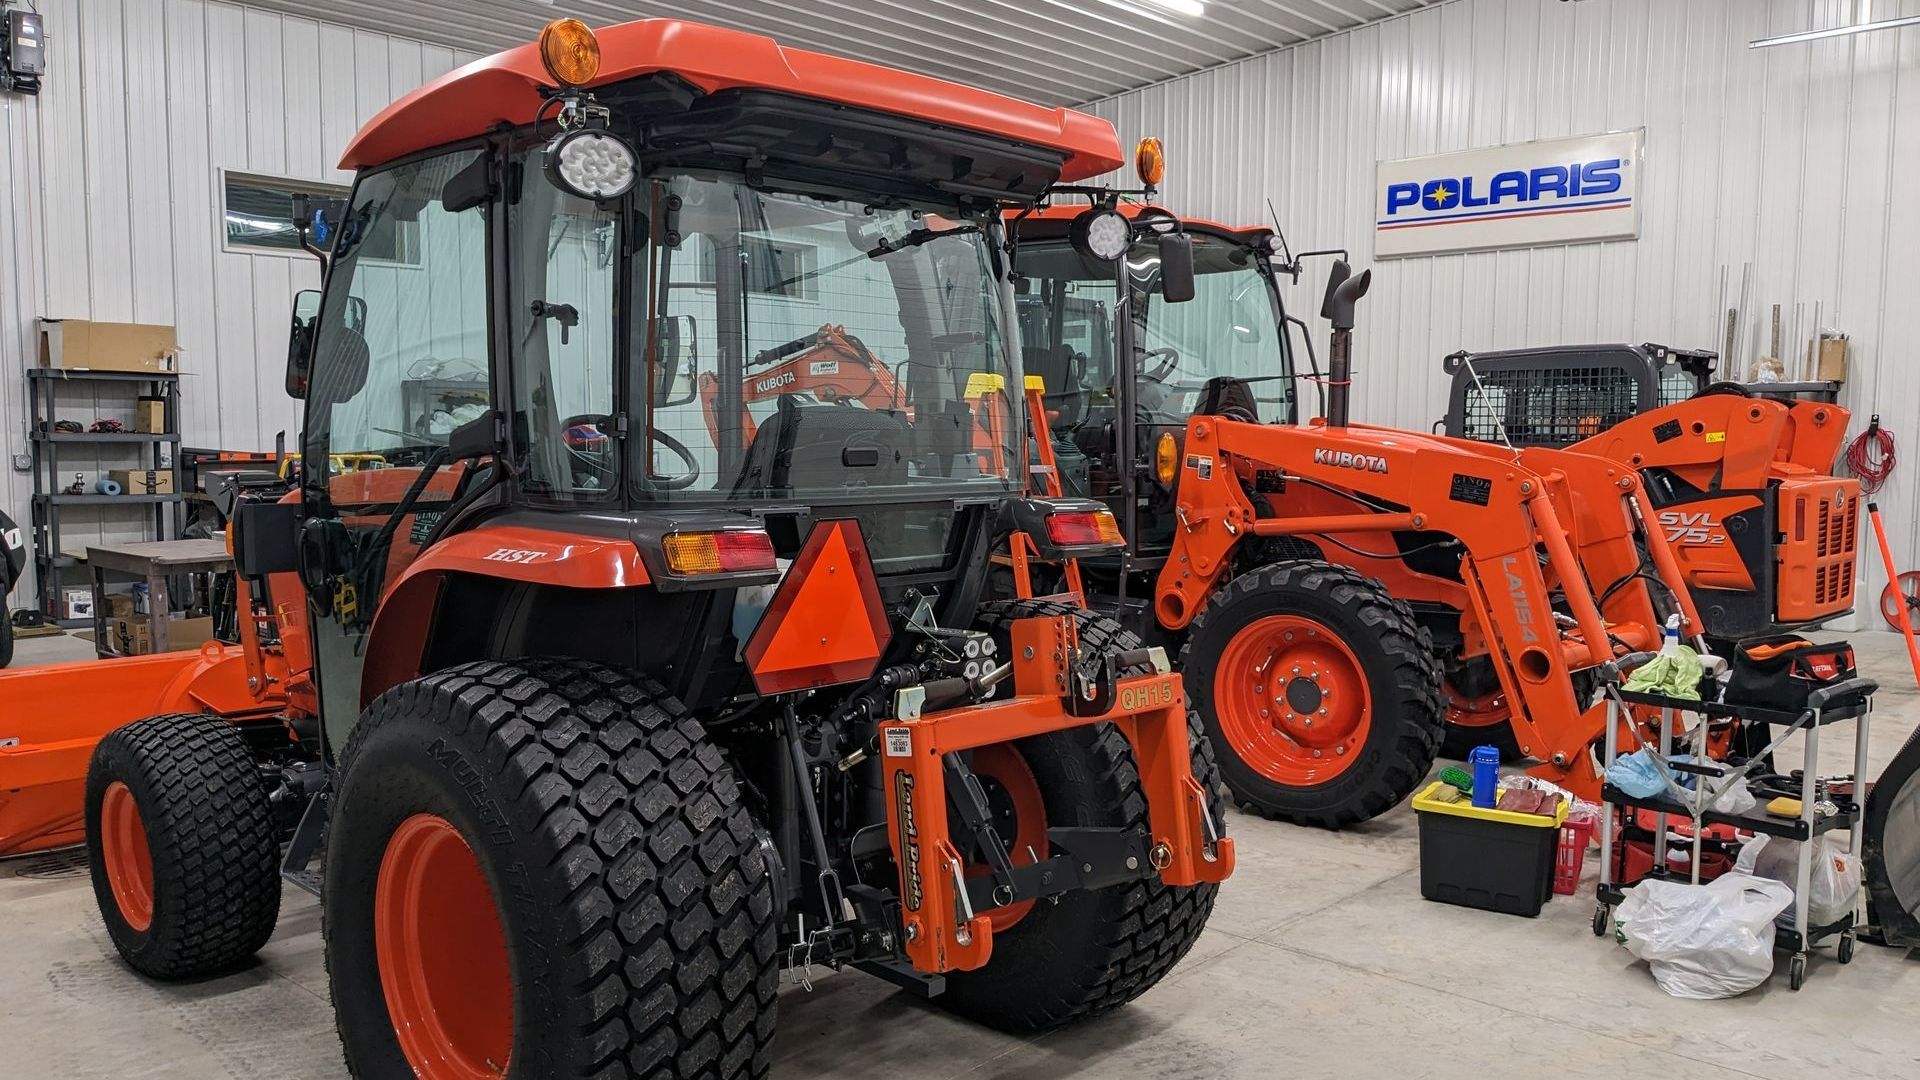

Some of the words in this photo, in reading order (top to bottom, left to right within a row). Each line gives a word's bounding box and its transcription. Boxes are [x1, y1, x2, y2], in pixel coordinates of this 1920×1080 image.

[1387, 158, 1622, 215] POLARIS
[756, 372, 796, 393] KUBOTA
[1314, 448, 1388, 474] KUBOTA
[1659, 512, 1721, 526] SVL
[1666, 527, 1726, 544] 75-2
[482, 548, 548, 564] HST
[1121, 681, 1173, 711] QH15
[425, 736, 517, 847] MULTI
[901, 773, 918, 838] Land
[907, 844, 923, 911] Pride
